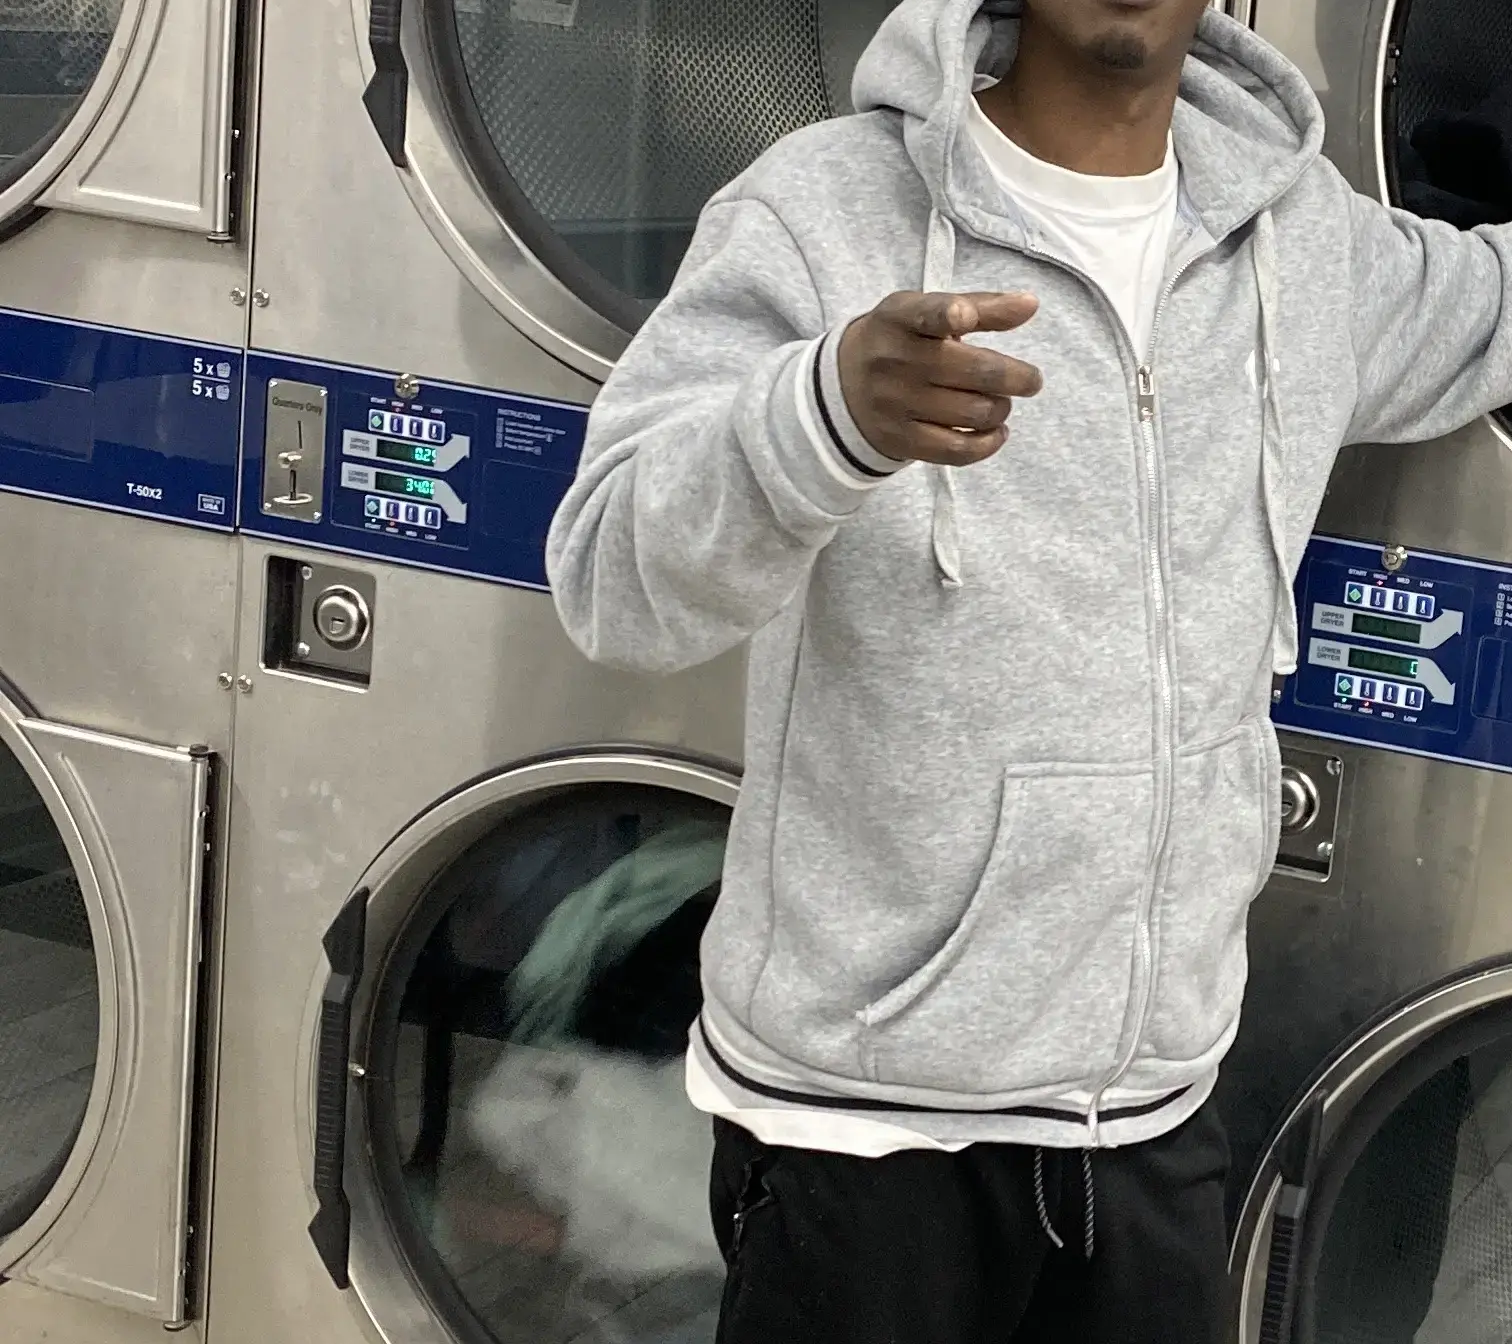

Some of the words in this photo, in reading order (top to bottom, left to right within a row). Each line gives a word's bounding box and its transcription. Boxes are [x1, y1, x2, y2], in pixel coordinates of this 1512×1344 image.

[193, 358, 203, 374] 5
[206, 364, 214, 376] x
[192, 380, 203, 396] 5
[205, 386, 213, 398] x
[127, 483, 162, 499] T-50X2
